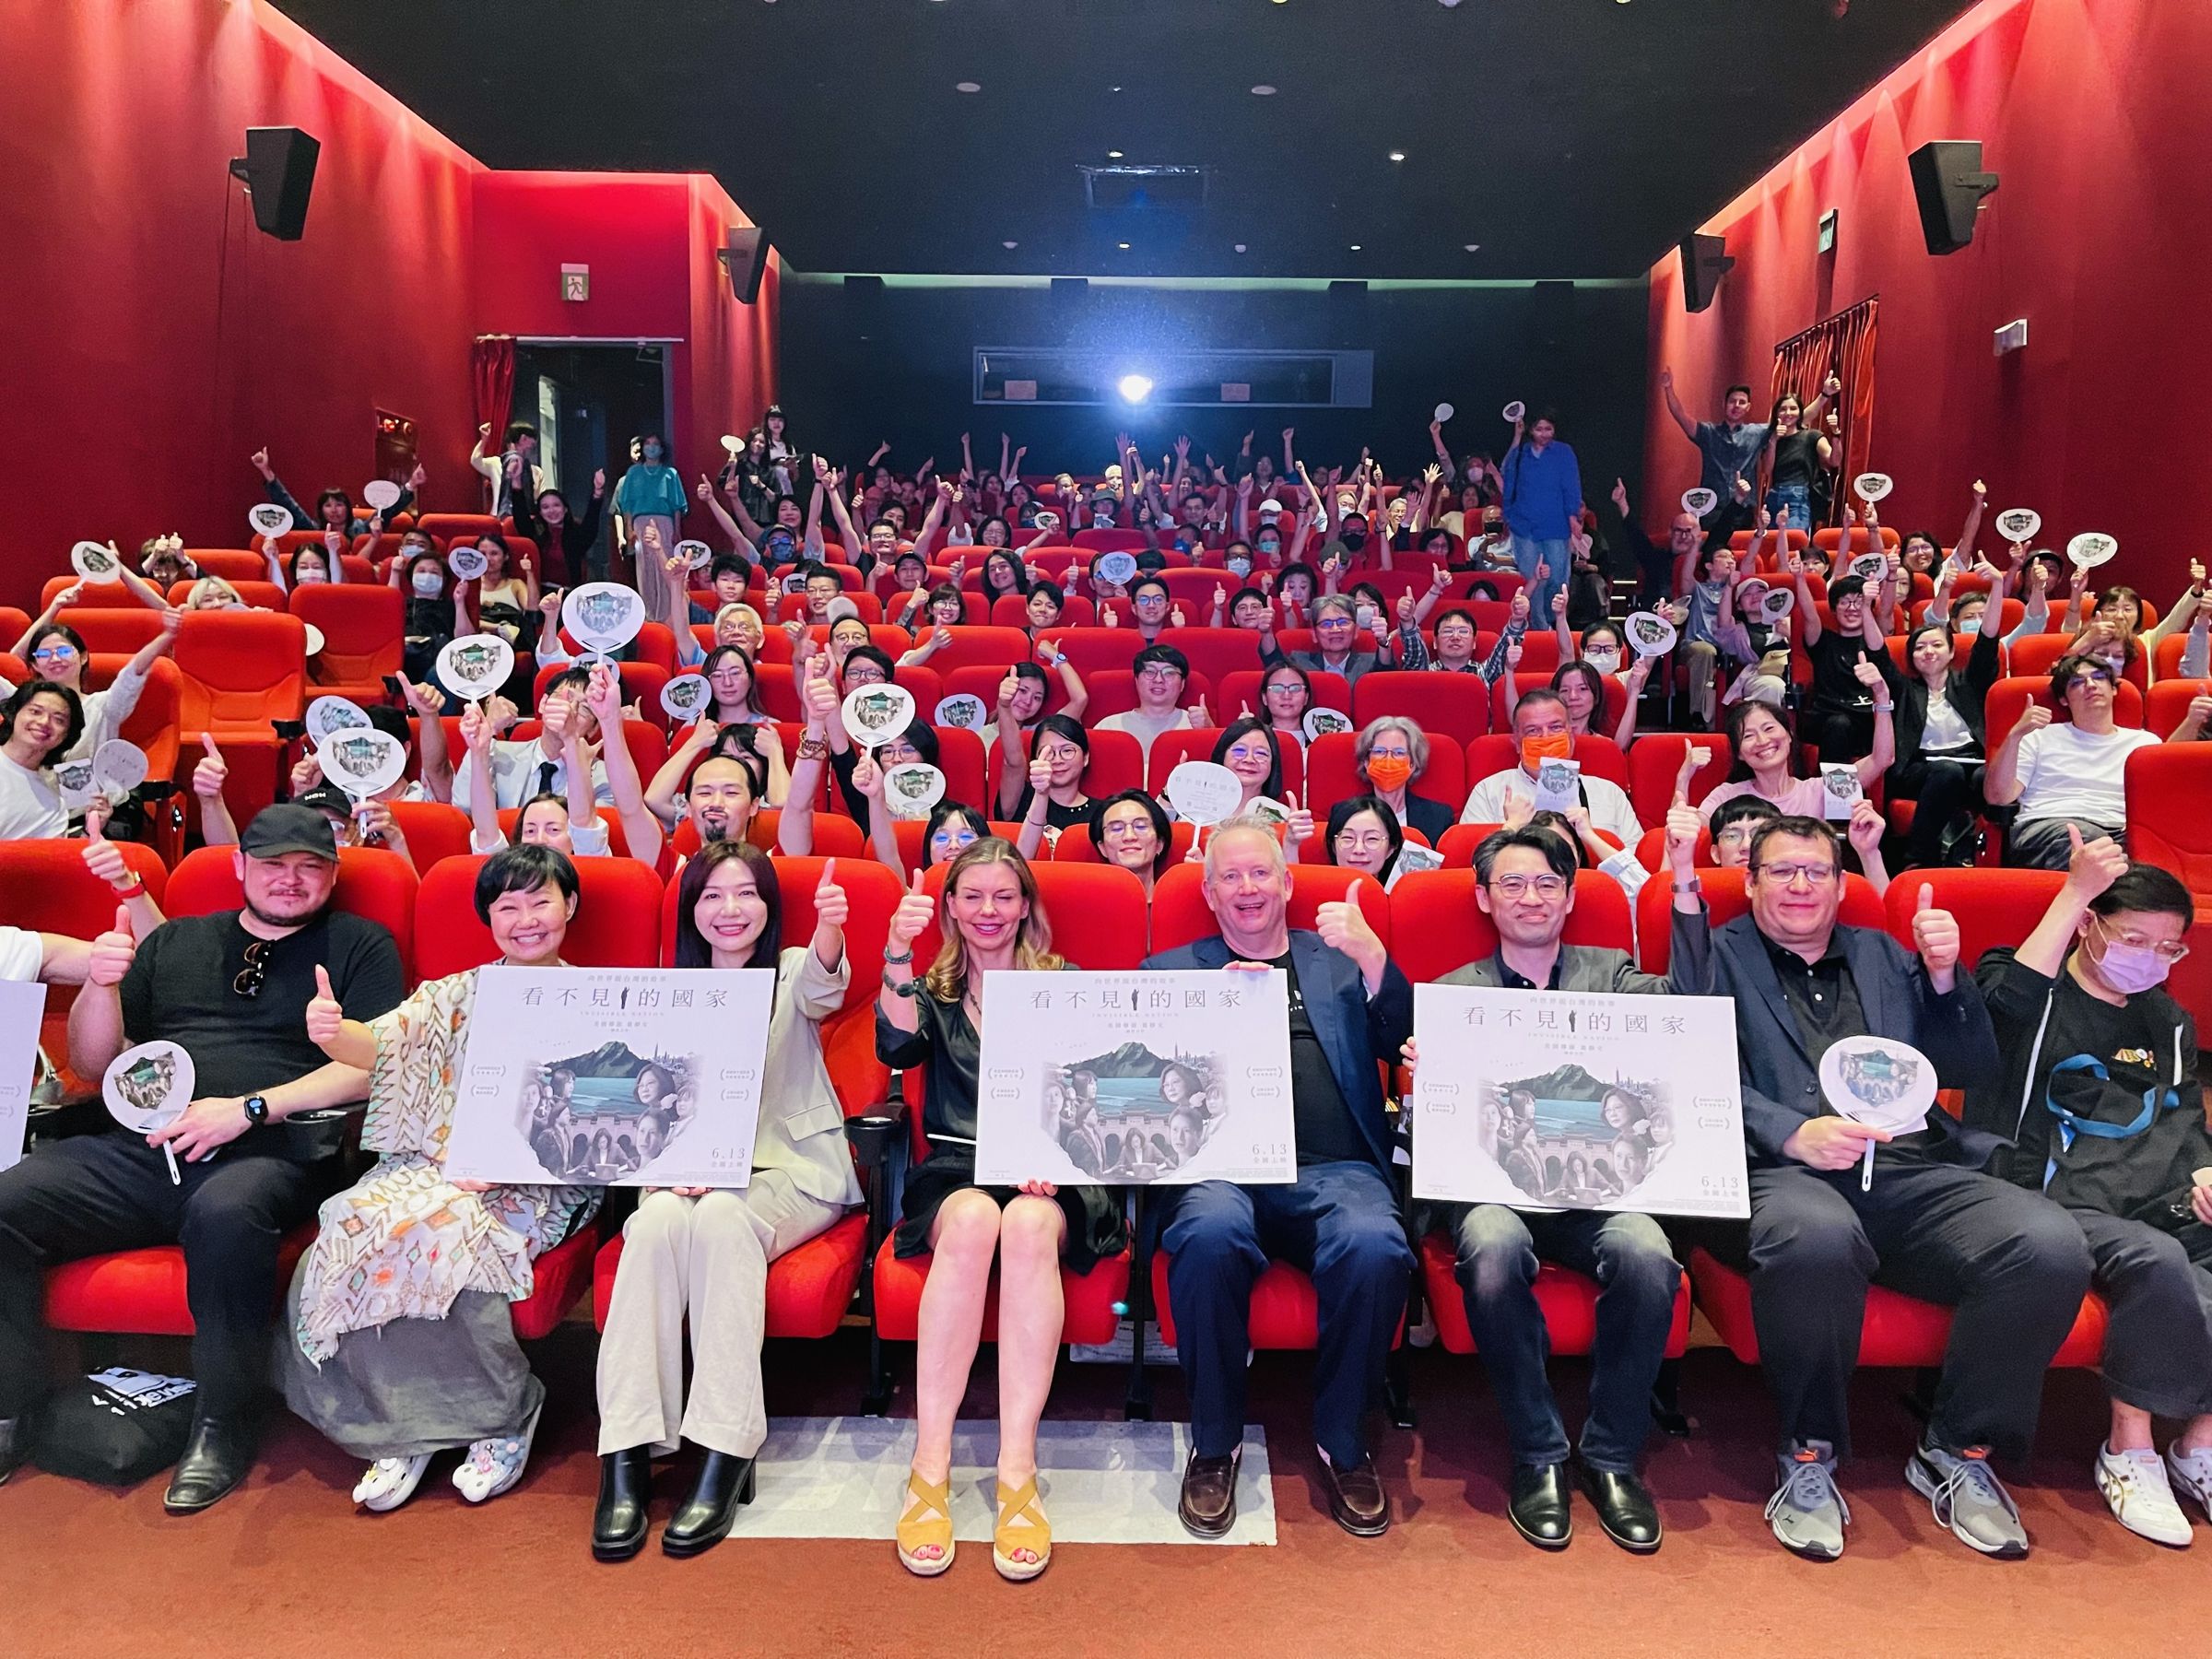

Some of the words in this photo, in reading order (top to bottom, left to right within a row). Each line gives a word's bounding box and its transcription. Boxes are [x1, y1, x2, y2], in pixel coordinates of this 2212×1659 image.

[522, 986, 728, 1008] 看不見的國家
[1030, 989, 1241, 1009] 看不見的國家
[1463, 1006, 1686, 1034] 看不見的國家
[712, 1147, 746, 1159] 6.13
[1252, 1143, 1287, 1155] 6.13
[1700, 1175, 1739, 1188] 6.13
